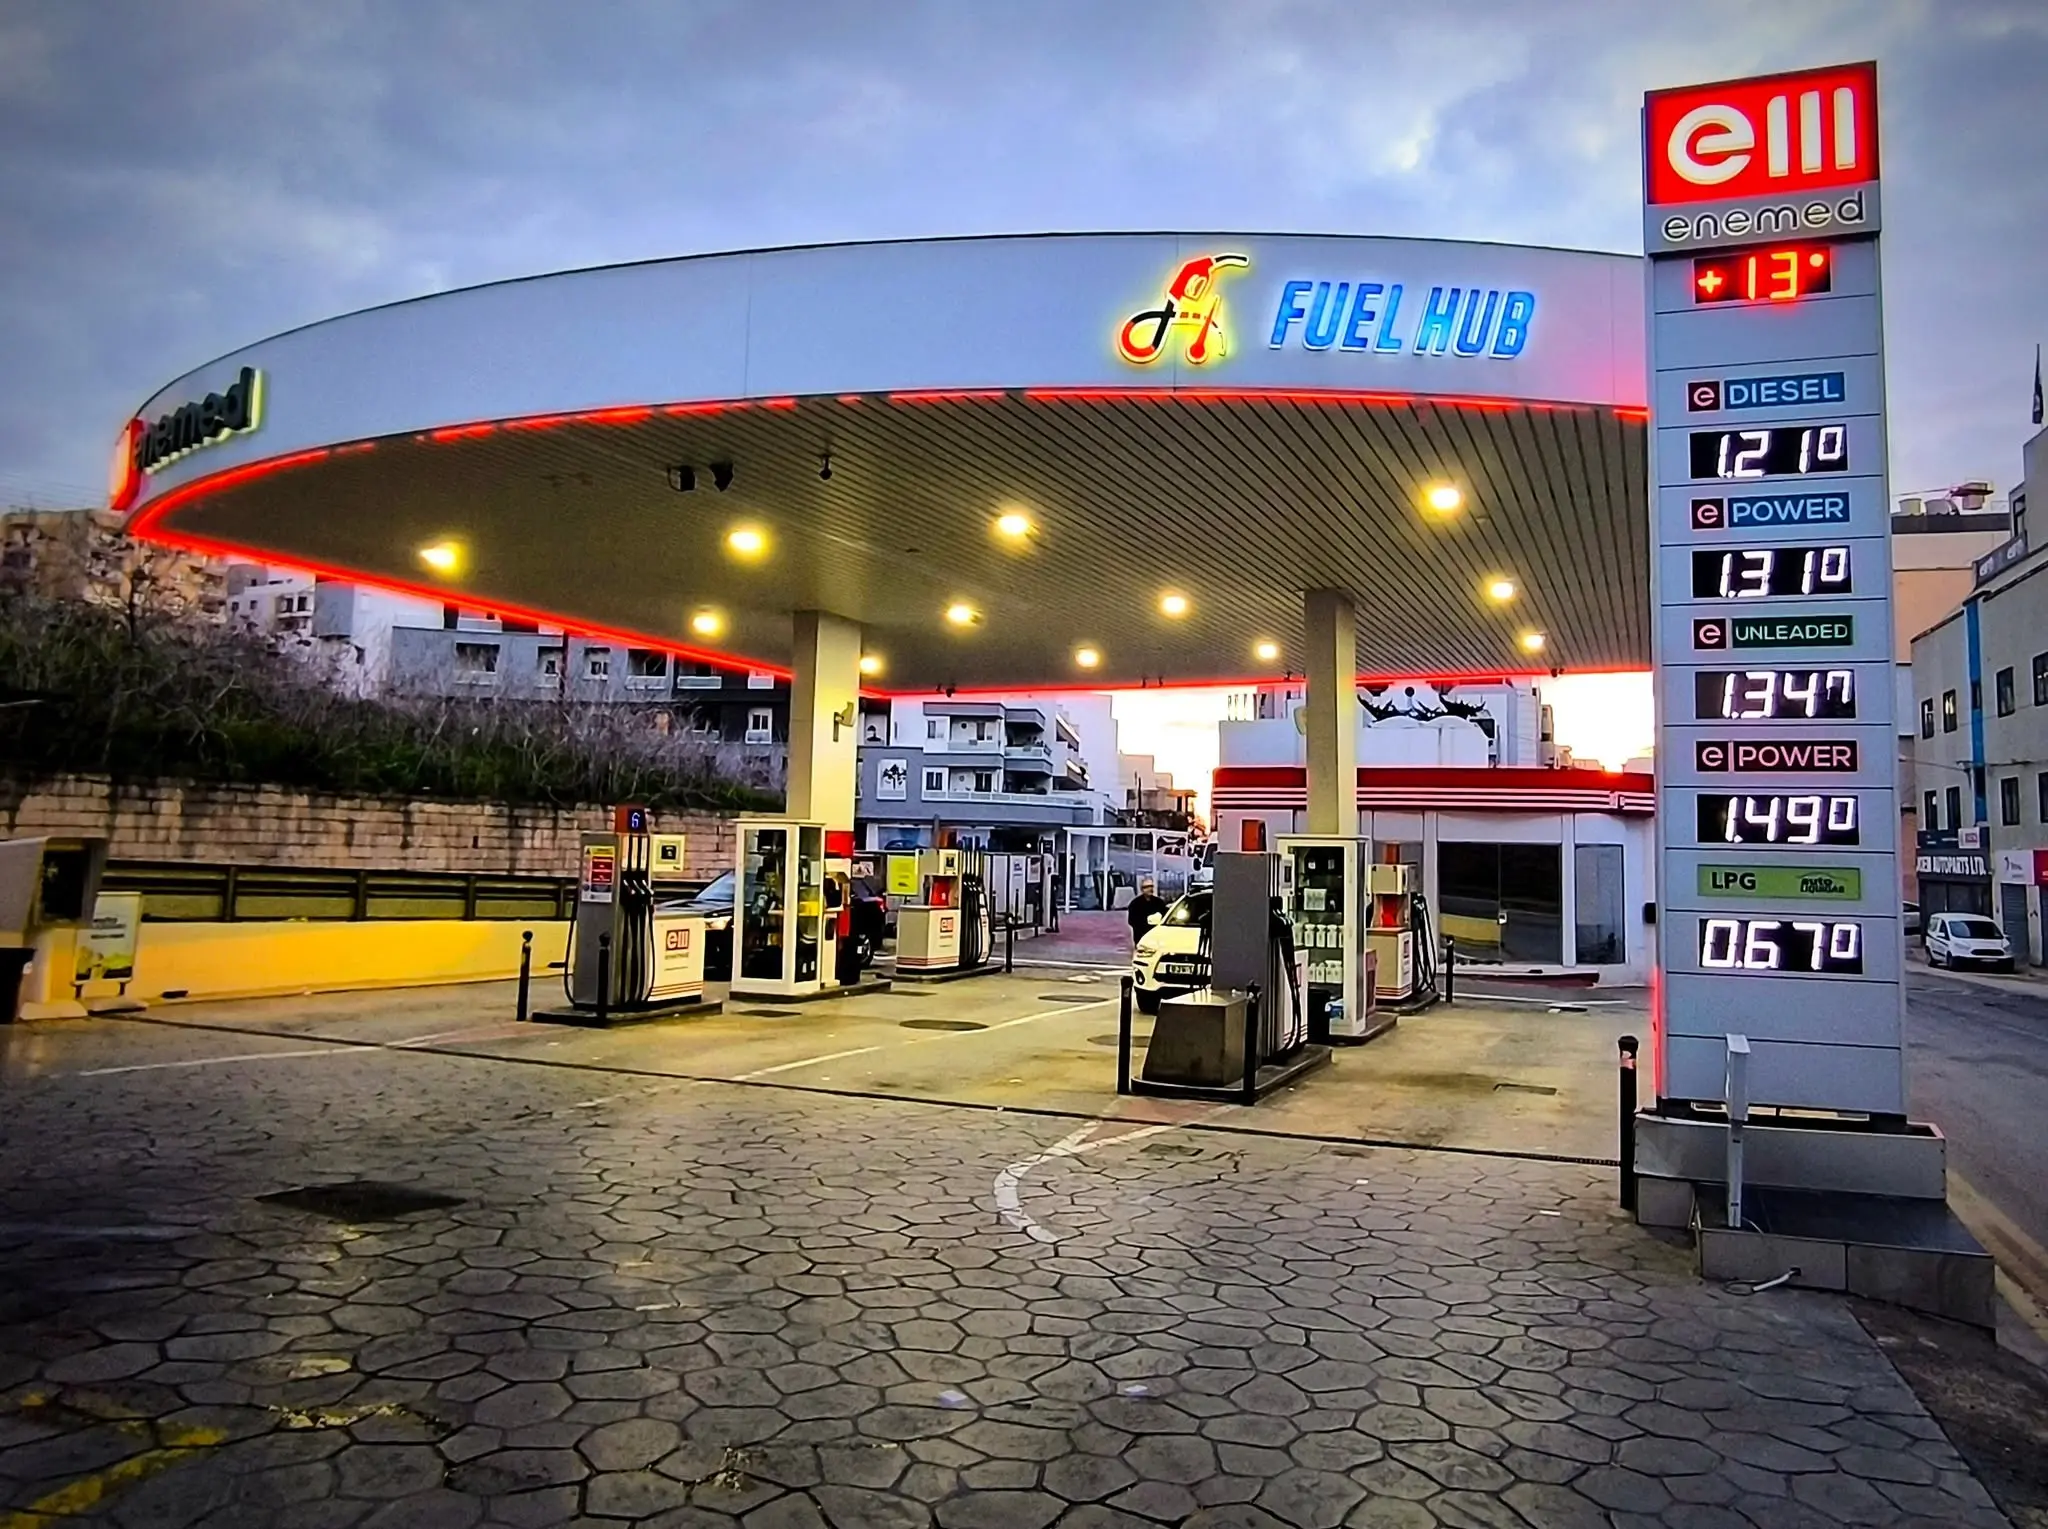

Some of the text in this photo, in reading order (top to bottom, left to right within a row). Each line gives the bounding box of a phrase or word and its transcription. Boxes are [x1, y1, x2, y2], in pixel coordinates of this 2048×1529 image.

[1661, 190, 1866, 242] enemed
[1269, 280, 1535, 360] FUEL HUB
[1728, 377, 1841, 407] DIESEL
[1733, 497, 1845, 524] POWER
[1735, 622, 1849, 642] UNLEADED
[1738, 745, 1852, 768] POWER
[1711, 871, 1757, 890] LPG
